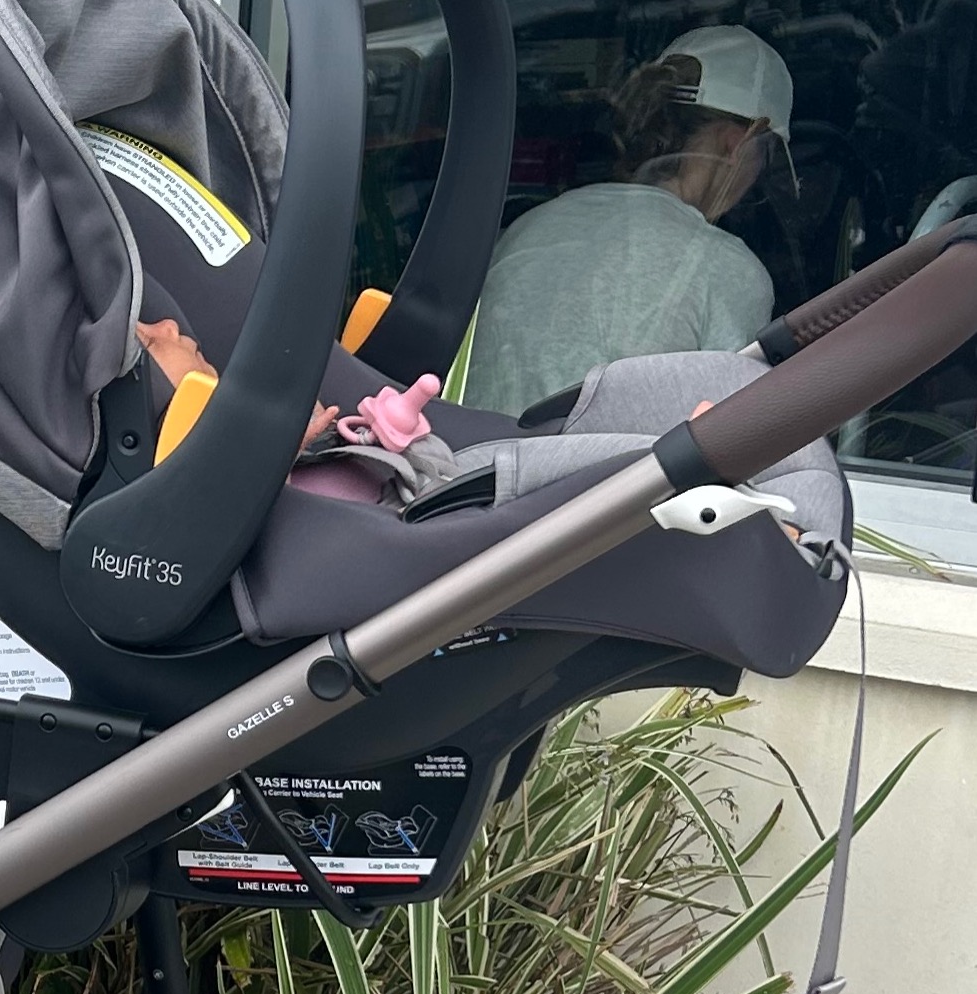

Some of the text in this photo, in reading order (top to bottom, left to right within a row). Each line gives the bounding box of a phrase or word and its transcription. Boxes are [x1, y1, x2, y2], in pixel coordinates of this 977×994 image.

[98, 126, 163, 160] WARNING
[132, 152, 176, 183] STRANGLED
[156, 561, 182, 586] 35
[228, 695, 294, 738] GAZELLE S
[292, 779, 381, 791] INSTALLATION
[237, 881, 259, 890] LINE
[262, 882, 293, 892] LEVEL
[296, 884, 309, 892] TO
